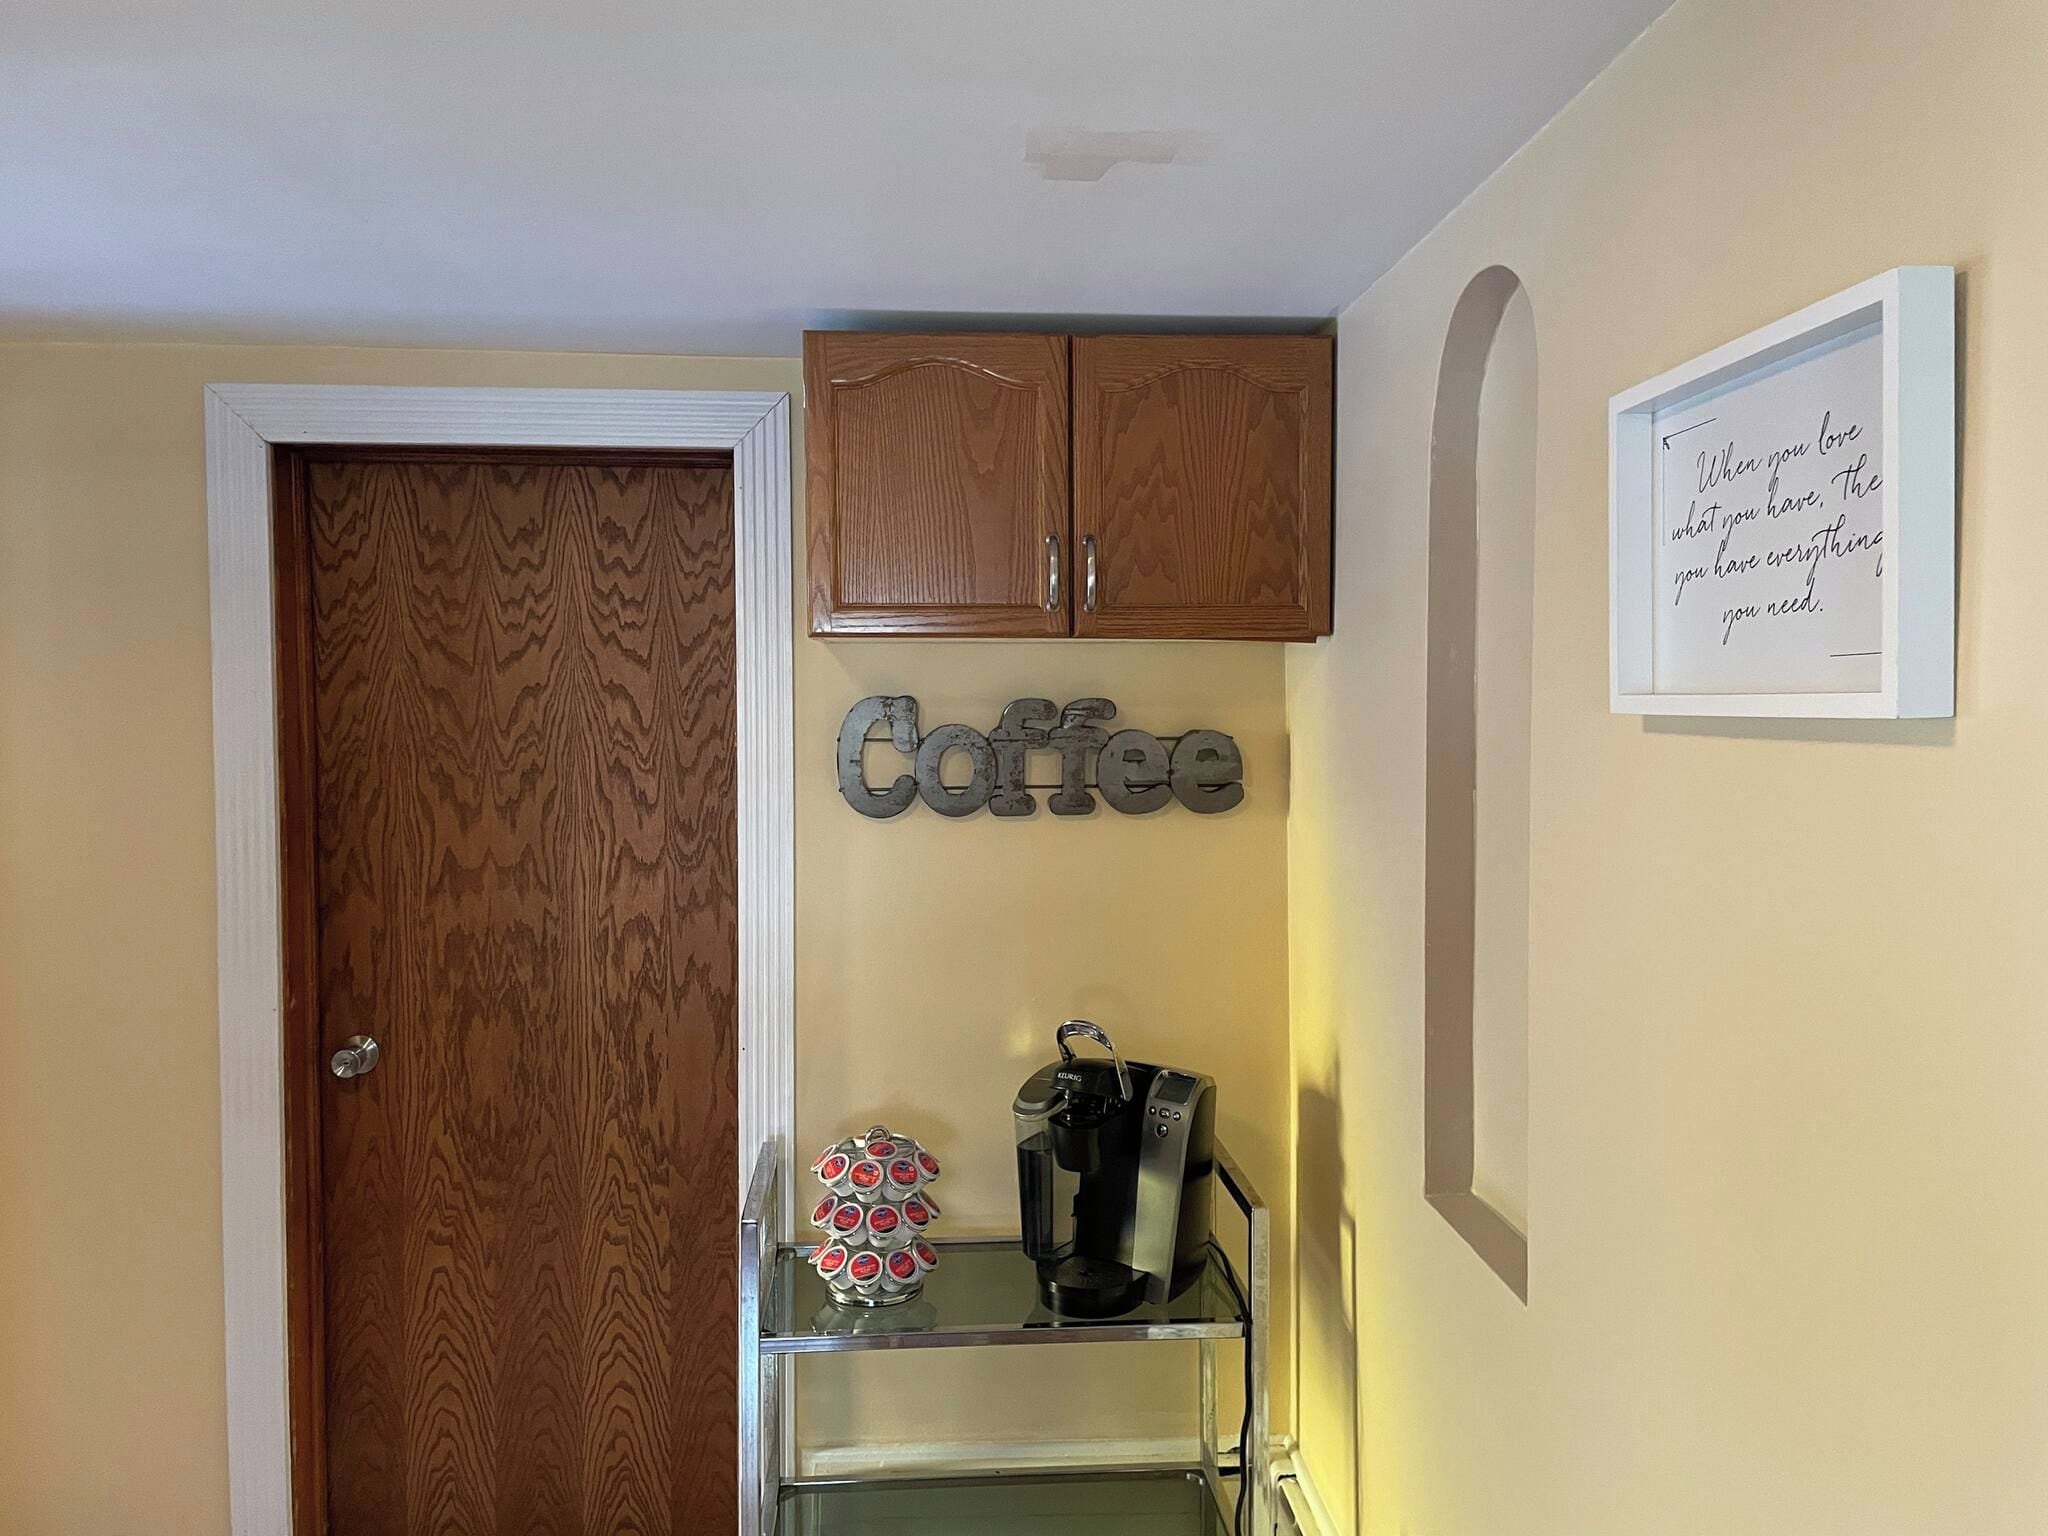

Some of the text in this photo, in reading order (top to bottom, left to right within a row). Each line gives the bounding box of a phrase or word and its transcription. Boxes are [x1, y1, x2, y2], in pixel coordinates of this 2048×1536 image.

[1696, 411, 1863, 493] When you love
[1672, 500, 1722, 541] what
[1722, 508, 1760, 551] you
[1767, 477, 1824, 518] have,
[1674, 567, 1709, 606] you
[1714, 539, 1761, 578] have
[1722, 577, 1823, 645] you need.
[837, 695, 1245, 818] Coffee
[1057, 1072, 1082, 1082] KEURIG
